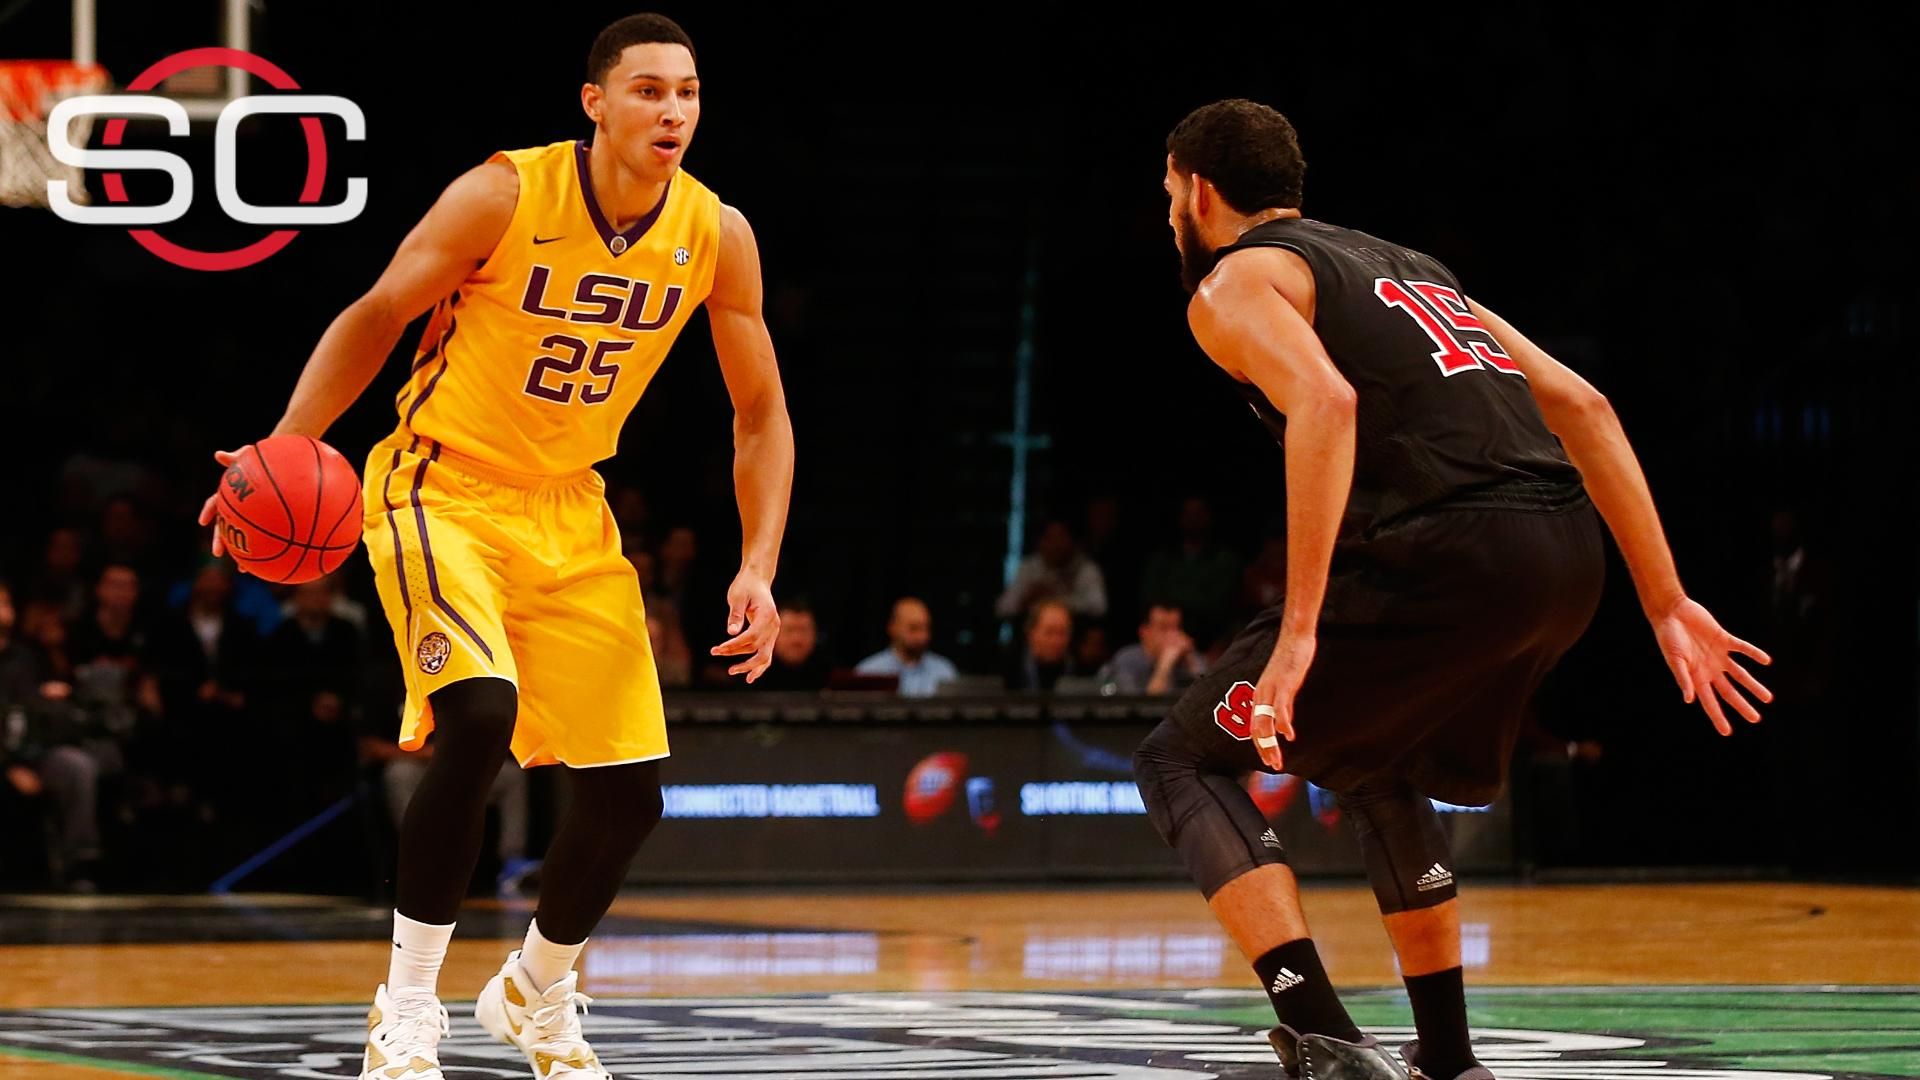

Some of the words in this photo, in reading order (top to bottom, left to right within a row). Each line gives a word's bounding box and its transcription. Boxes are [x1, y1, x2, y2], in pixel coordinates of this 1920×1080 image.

[520, 265, 684, 333] LSU
[1373, 277, 1527, 379] 15
[522, 334, 636, 406] 25
[1416, 870, 1453, 885] adidas
[1272, 974, 1305, 993] adidas
